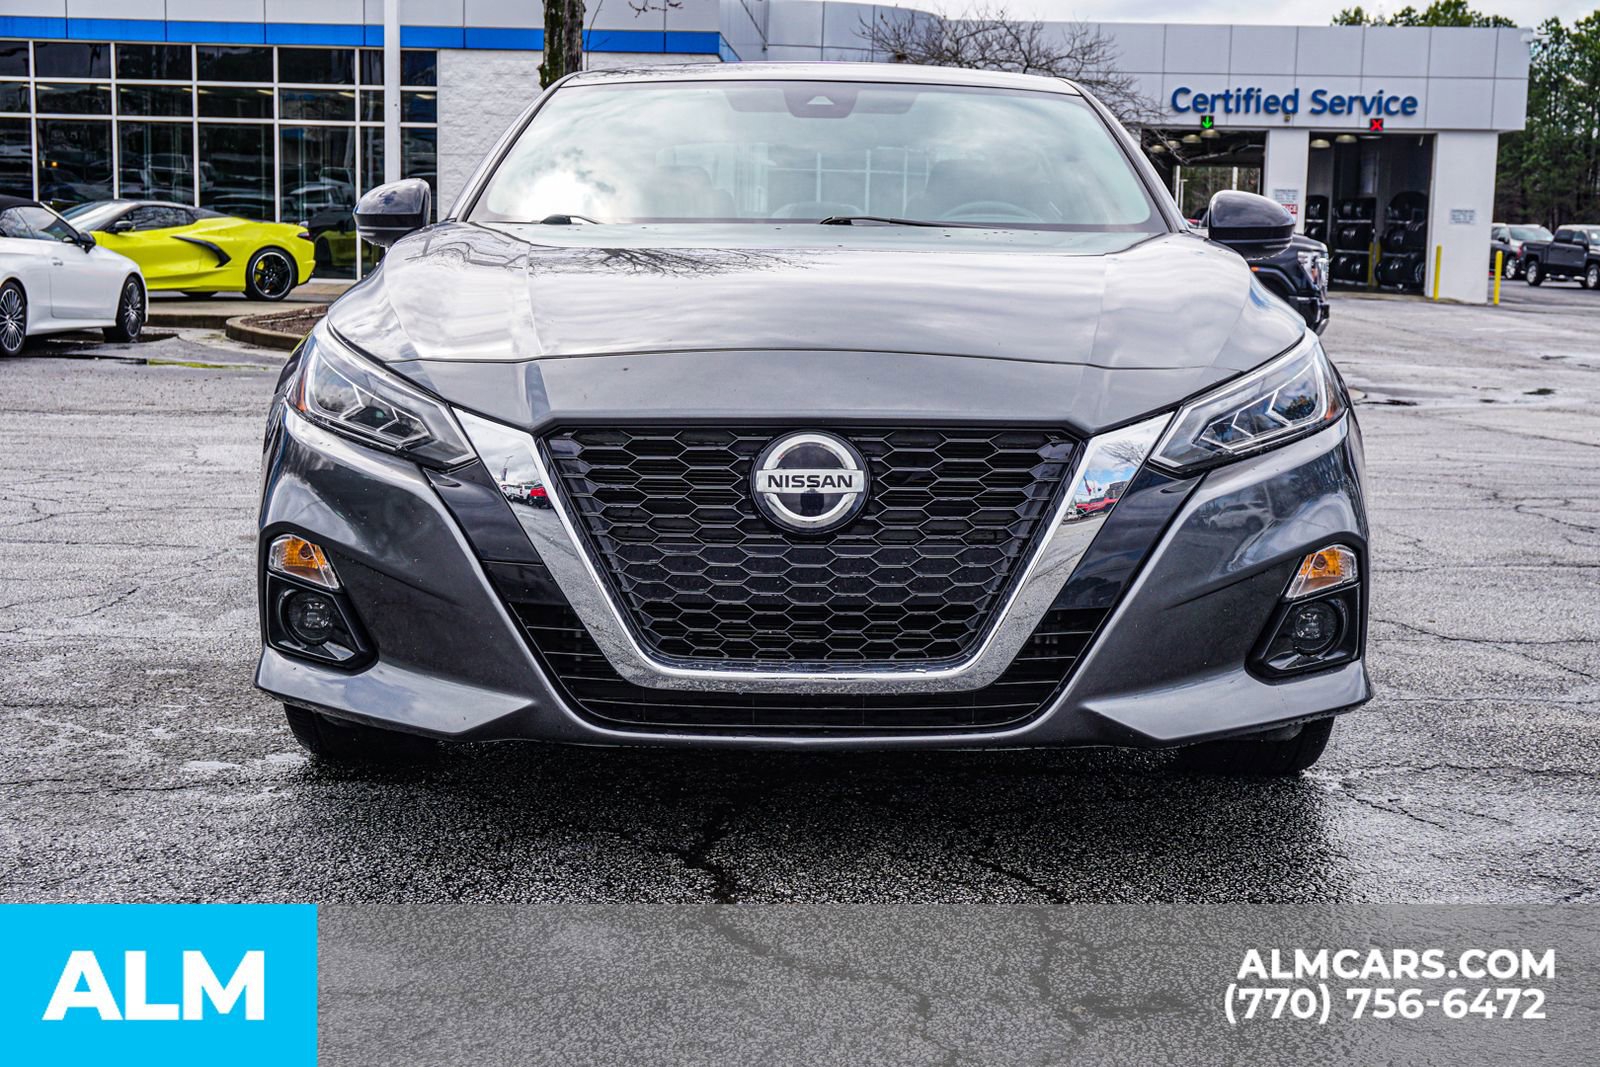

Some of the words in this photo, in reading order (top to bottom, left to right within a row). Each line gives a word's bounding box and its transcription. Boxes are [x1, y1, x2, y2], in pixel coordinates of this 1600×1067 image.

[1171, 87, 1299, 115] Certified
[1310, 89, 1418, 116] Service
[767, 475, 853, 488] NISSAN
